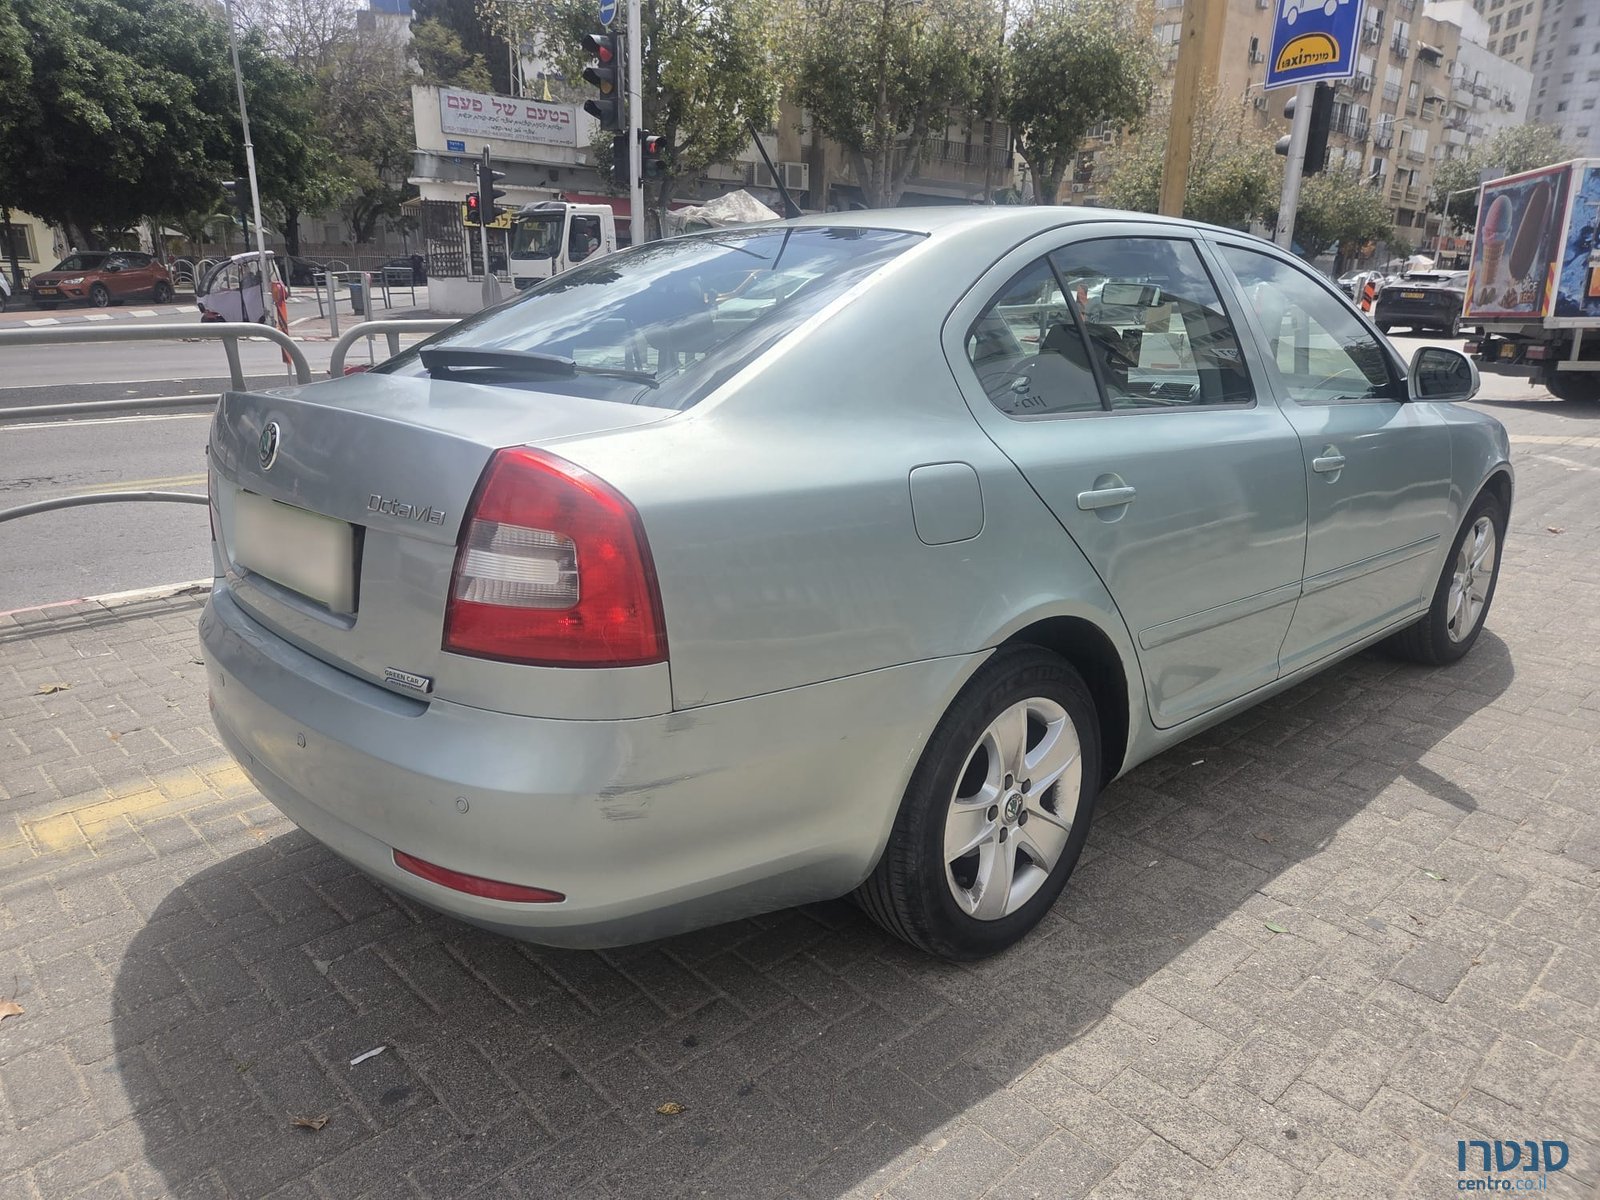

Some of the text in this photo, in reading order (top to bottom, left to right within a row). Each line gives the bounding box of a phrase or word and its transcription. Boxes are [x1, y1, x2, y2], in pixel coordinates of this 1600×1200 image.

[1282, 48, 1303, 68] taxi
[1303, 52, 1329, 64] מונית
[447, 95, 483, 112] פעם
[491, 98, 517, 116] של
[526, 106, 570, 124] בטעם
[367, 493, 446, 526] Octavia
[384, 669, 420, 685] GREEN CAR
